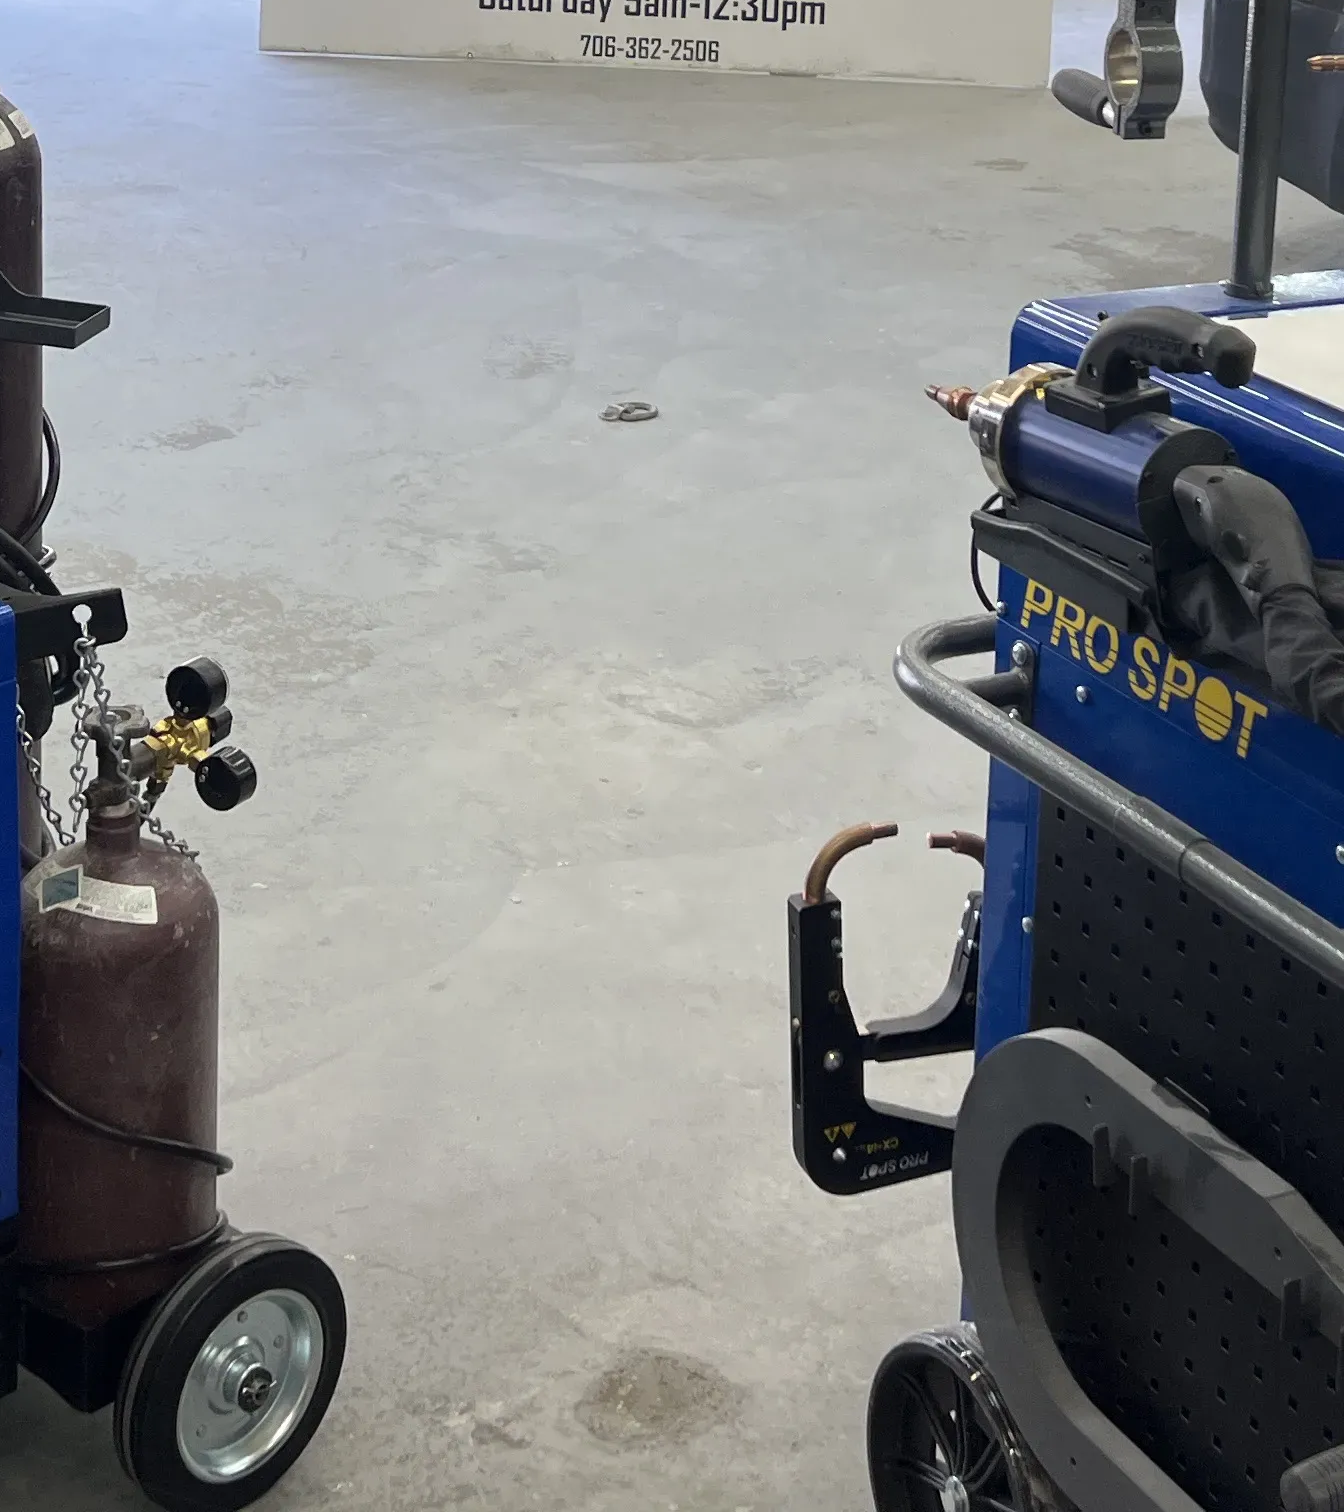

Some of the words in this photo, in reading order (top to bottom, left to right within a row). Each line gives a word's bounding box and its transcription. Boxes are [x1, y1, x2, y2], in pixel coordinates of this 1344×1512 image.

[579, 35, 720, 64] 706-362-2506
[1020, 577, 1119, 675] PRO
[1127, 636, 1269, 760] SPOT
